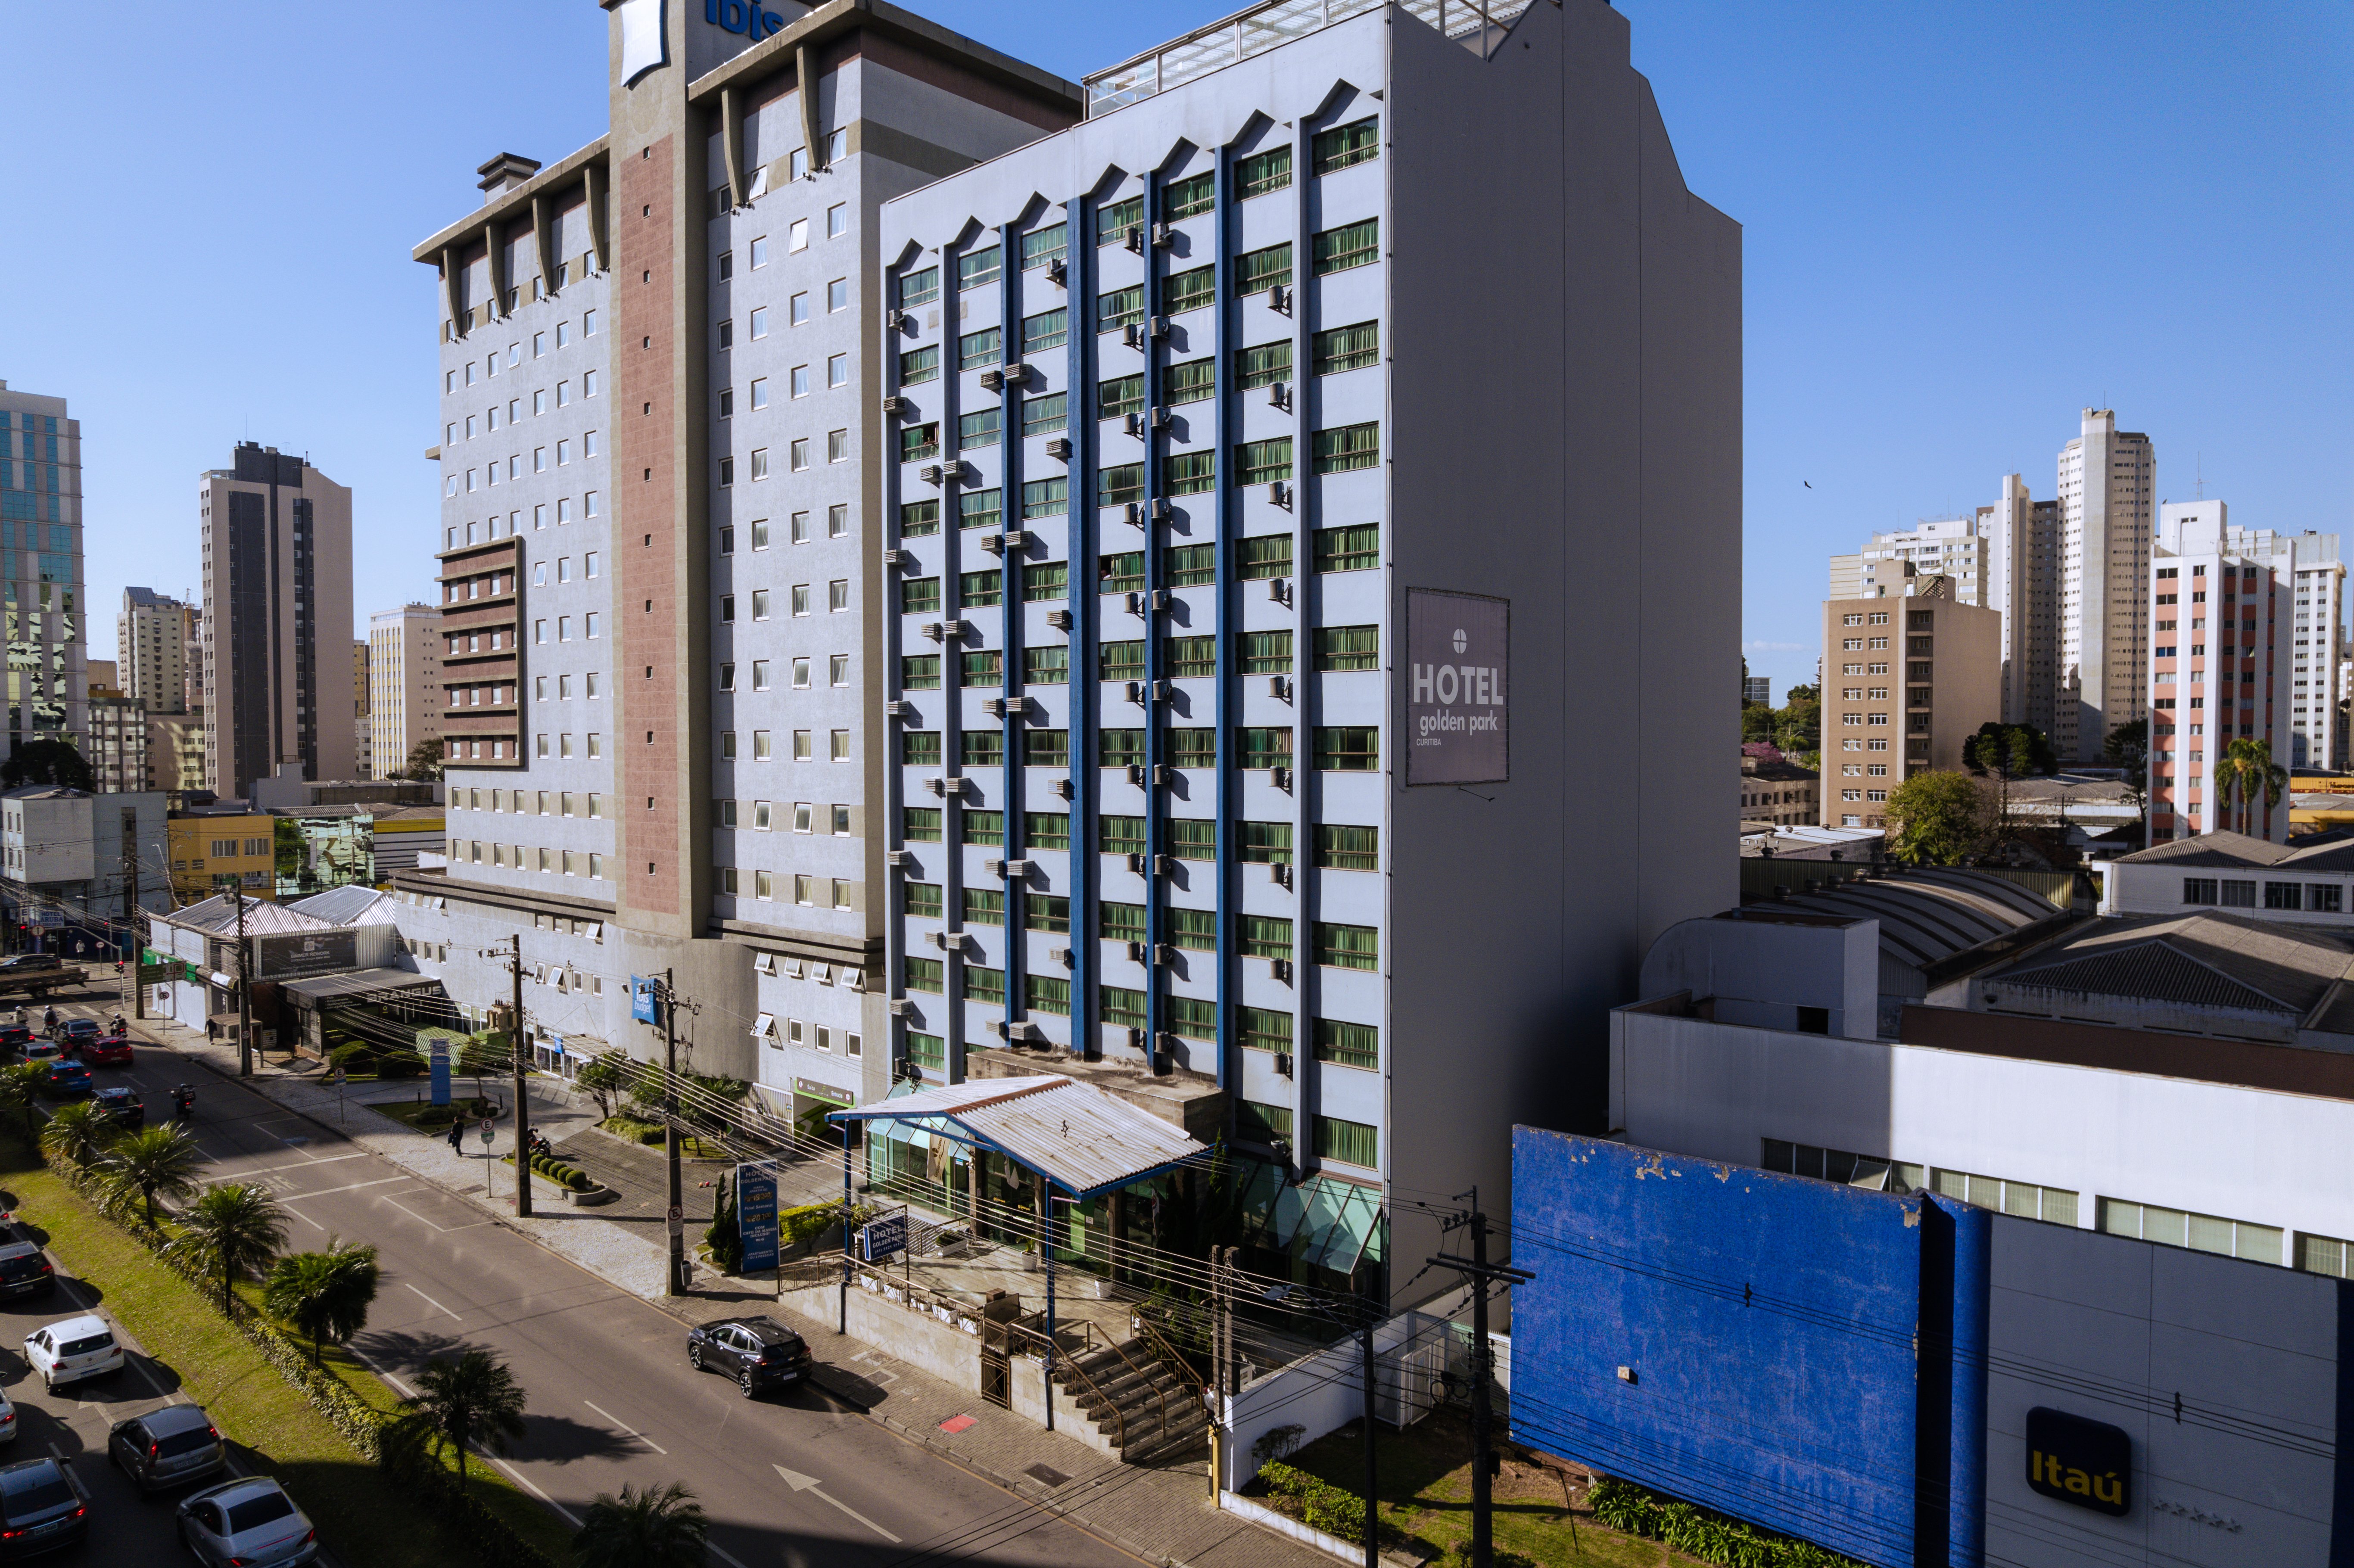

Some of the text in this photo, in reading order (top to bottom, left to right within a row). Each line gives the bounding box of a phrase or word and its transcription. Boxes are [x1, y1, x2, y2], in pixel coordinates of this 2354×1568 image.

[705, 0, 783, 42] ibis
[1413, 663, 1504, 705] HOTEL
[1420, 709, 1498, 736] golden park
[1416, 738, 1442, 746] CURITIBA
[367, 986, 442, 1003] BRANGUS
[634, 1000, 651, 1014] budget
[872, 1233, 904, 1248] GOLDEN PARK
[873, 1225, 903, 1240] HOTEL
[2032, 1449, 2122, 1506] Itaú
